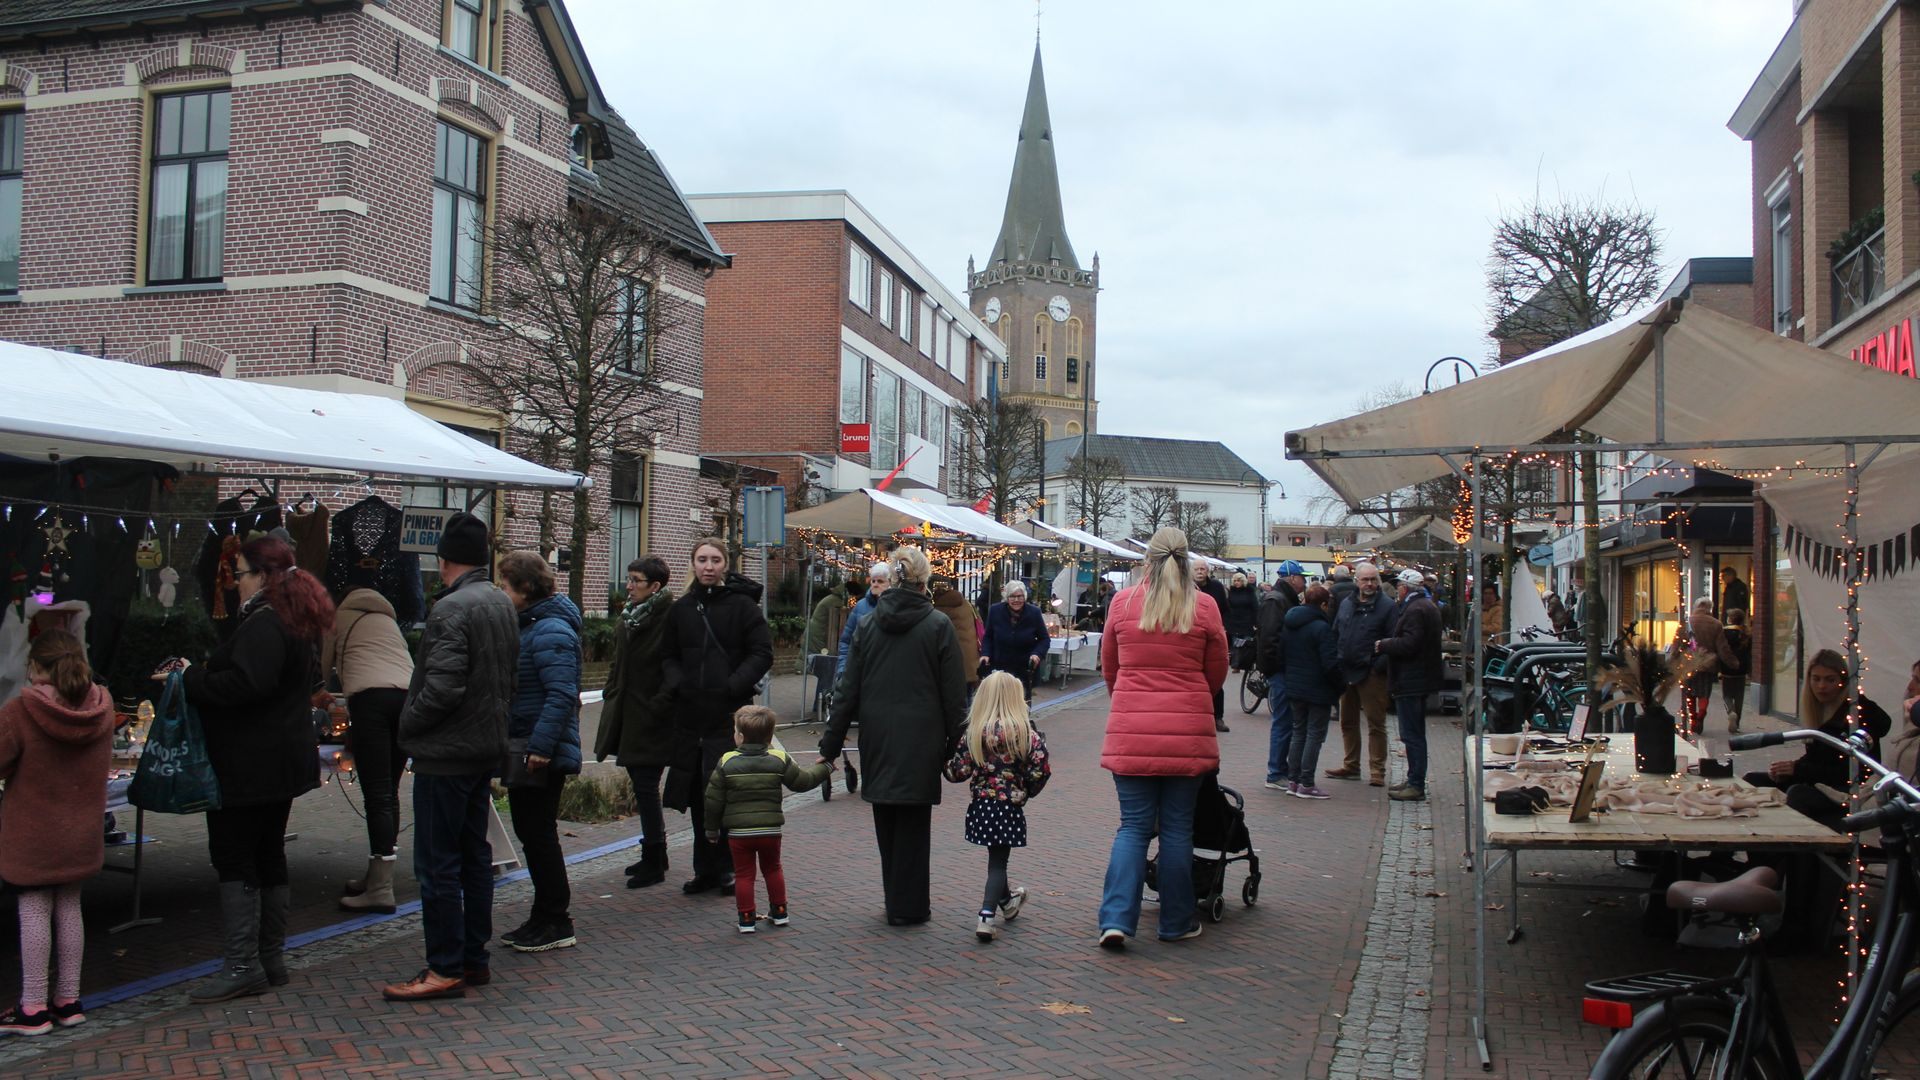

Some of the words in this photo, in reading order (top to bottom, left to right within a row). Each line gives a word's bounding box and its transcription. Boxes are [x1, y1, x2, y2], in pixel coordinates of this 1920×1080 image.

[843, 433, 869, 441] bruna
[404, 514, 443, 530] PINNEN
[402, 530, 416, 545] JA
[419, 531, 441, 546] GRA
